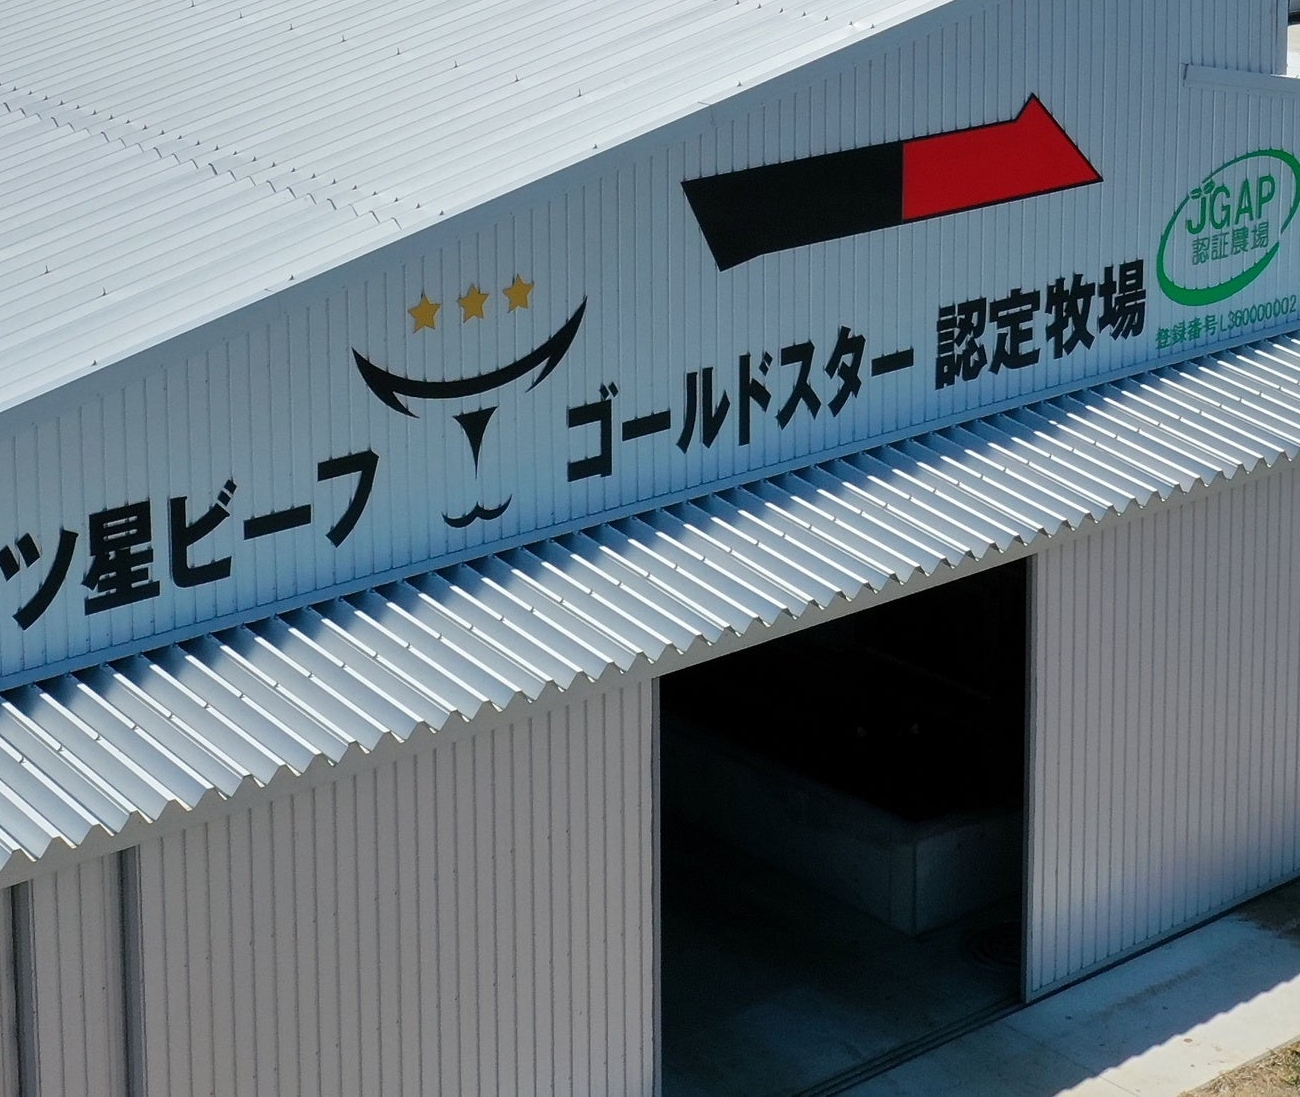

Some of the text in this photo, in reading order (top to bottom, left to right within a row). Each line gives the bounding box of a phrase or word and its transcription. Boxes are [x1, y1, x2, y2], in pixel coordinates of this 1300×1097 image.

[1186, 174, 1276, 235] JGAP
[1192, 221, 1269, 265] 認証農場
[566, 324, 914, 482] ゴールドスター
[934, 258, 1146, 389] 認定牧場
